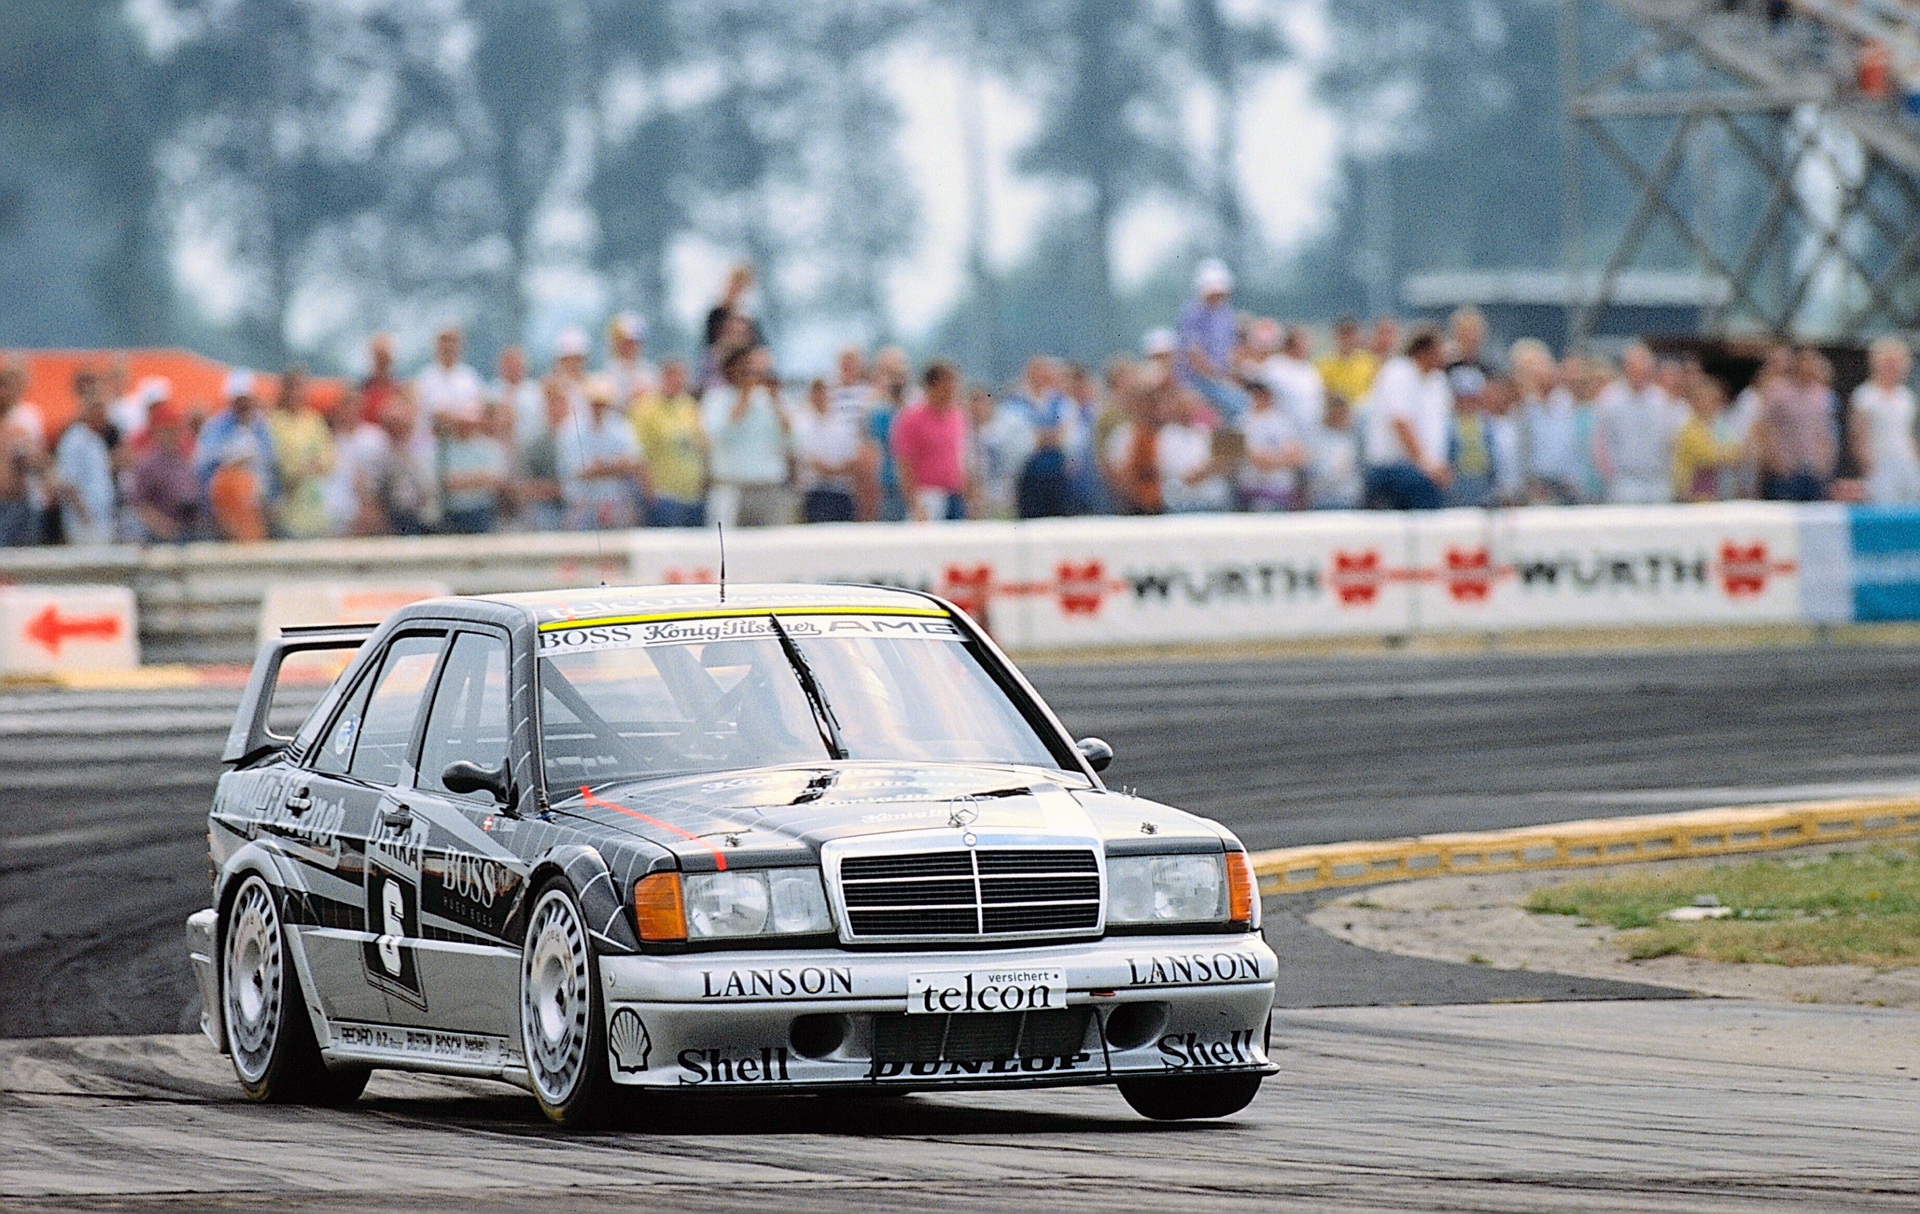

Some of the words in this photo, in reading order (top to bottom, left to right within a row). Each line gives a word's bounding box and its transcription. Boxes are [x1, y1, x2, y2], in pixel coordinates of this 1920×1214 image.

[540, 627, 632, 649] BOSS
[829, 620, 957, 634] AMG
[443, 845, 496, 909] BOSS
[379, 877, 405, 977] 6
[700, 967, 853, 998] LANSON
[989, 971, 1049, 983] versichert
[1125, 952, 1261, 985] LANSON
[922, 973, 1052, 1012] telcon
[678, 1047, 791, 1085] Shell
[863, 1052, 1091, 1079] DUNLOP
[1157, 1028, 1254, 1069] Shell
